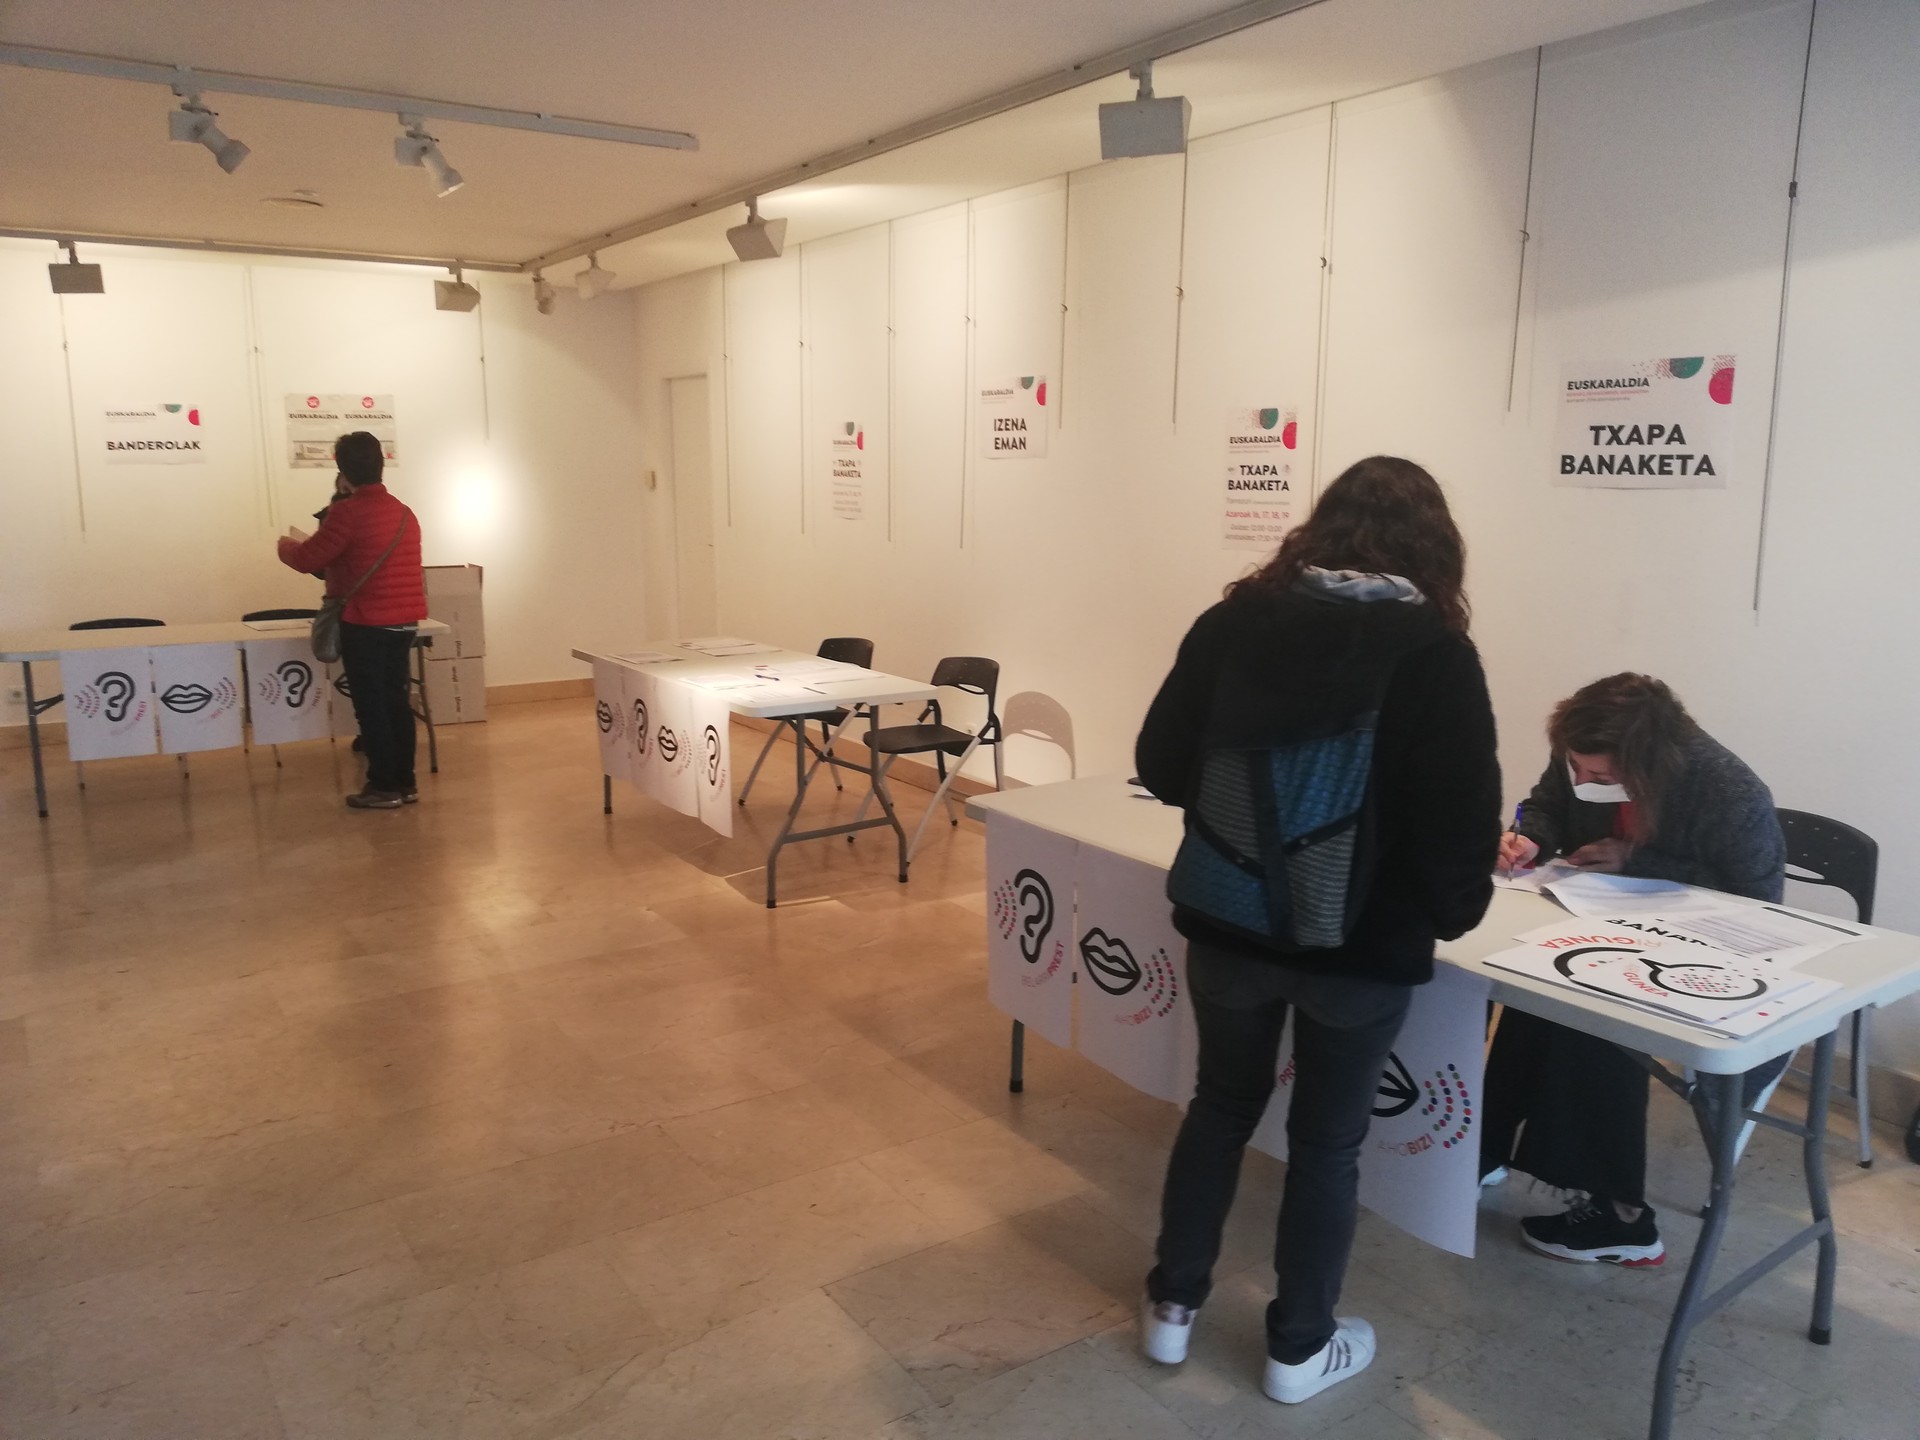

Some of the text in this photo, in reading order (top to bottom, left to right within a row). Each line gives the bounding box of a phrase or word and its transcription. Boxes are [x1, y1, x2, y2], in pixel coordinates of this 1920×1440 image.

[1567, 377, 1650, 391] EUSKARALDIA
[993, 418, 1028, 432] IZENA
[1589, 424, 1687, 446] TXAPA
[106, 440, 201, 451] BANDEROLAK
[994, 436, 1027, 450] EMAN
[1240, 464, 1279, 476] TXAPA
[1560, 454, 1717, 476] BANAKETA
[1227, 480, 1290, 491] BANAKETA
